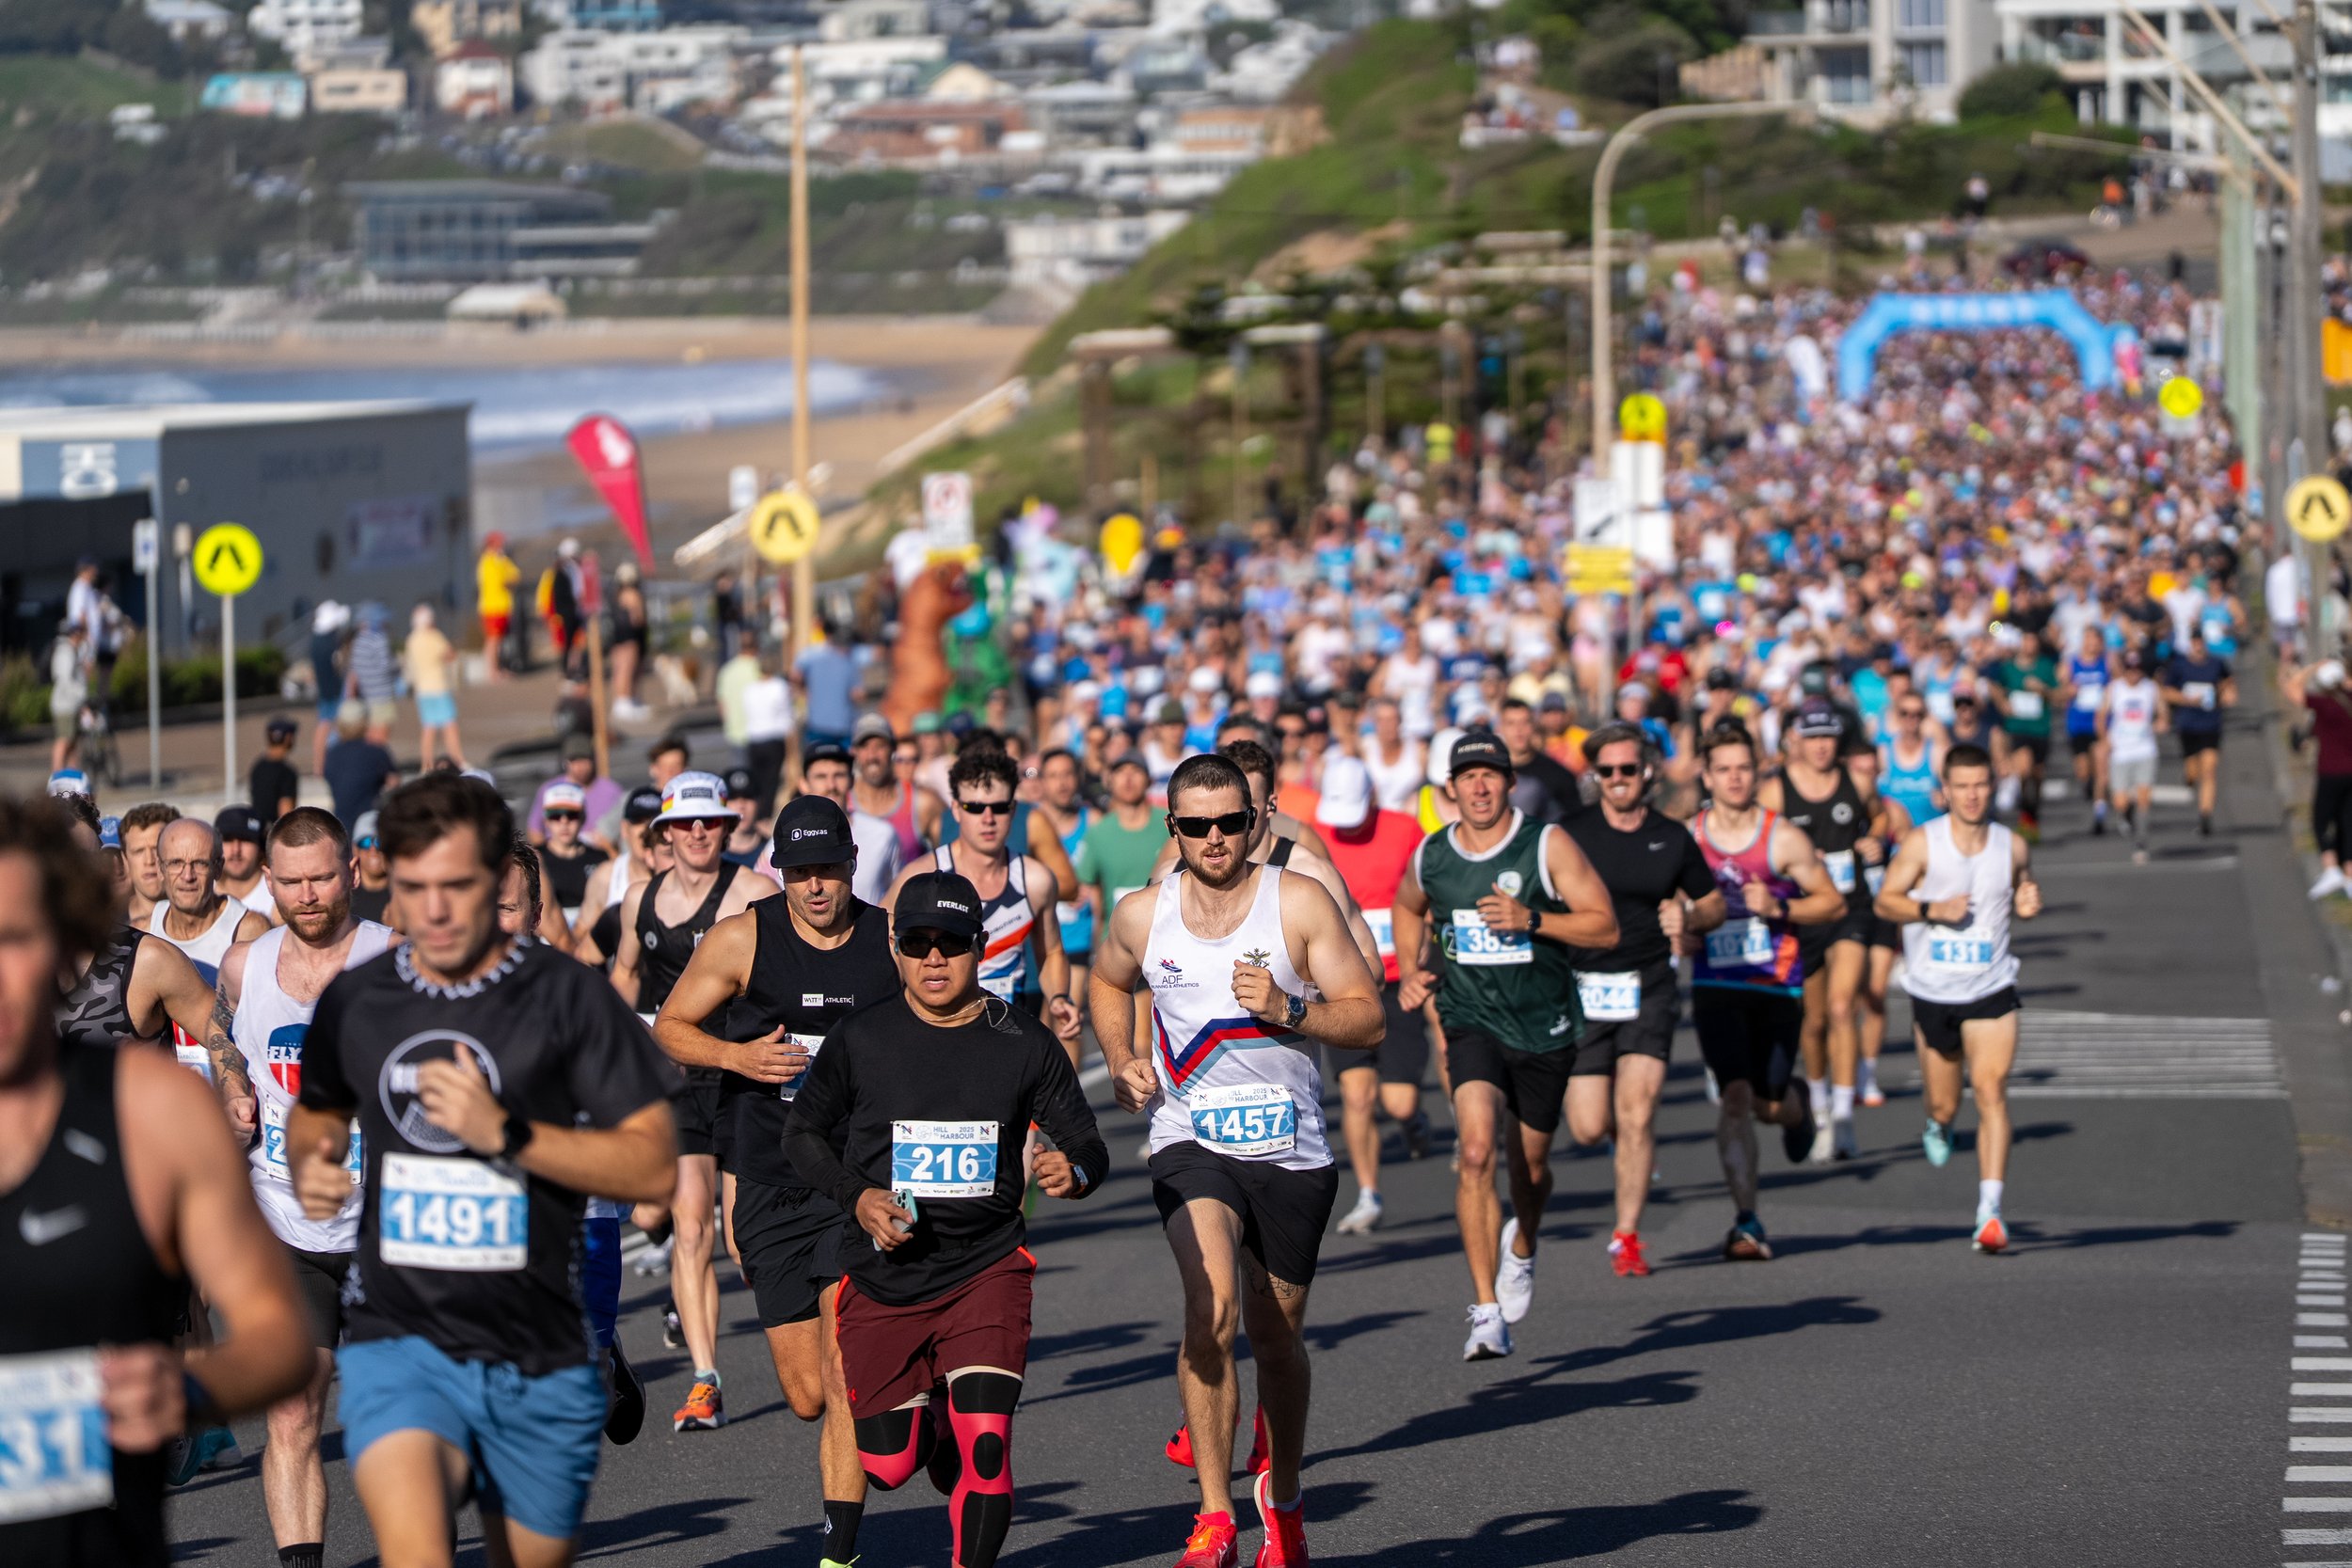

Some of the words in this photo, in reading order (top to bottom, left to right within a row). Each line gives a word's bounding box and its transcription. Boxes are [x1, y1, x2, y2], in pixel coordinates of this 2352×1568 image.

[803, 829, 828, 837] Eggy.as
[937, 900, 969, 913] EVERLAST
[1941, 941, 1980, 962] 131
[1162, 974, 1183, 985] ADF
[1235, 1093, 1269, 1102] HARBOUR
[1200, 1105, 1287, 1141] 1457
[911, 1146, 979, 1180] 216
[391, 1191, 510, 1246] 1491
